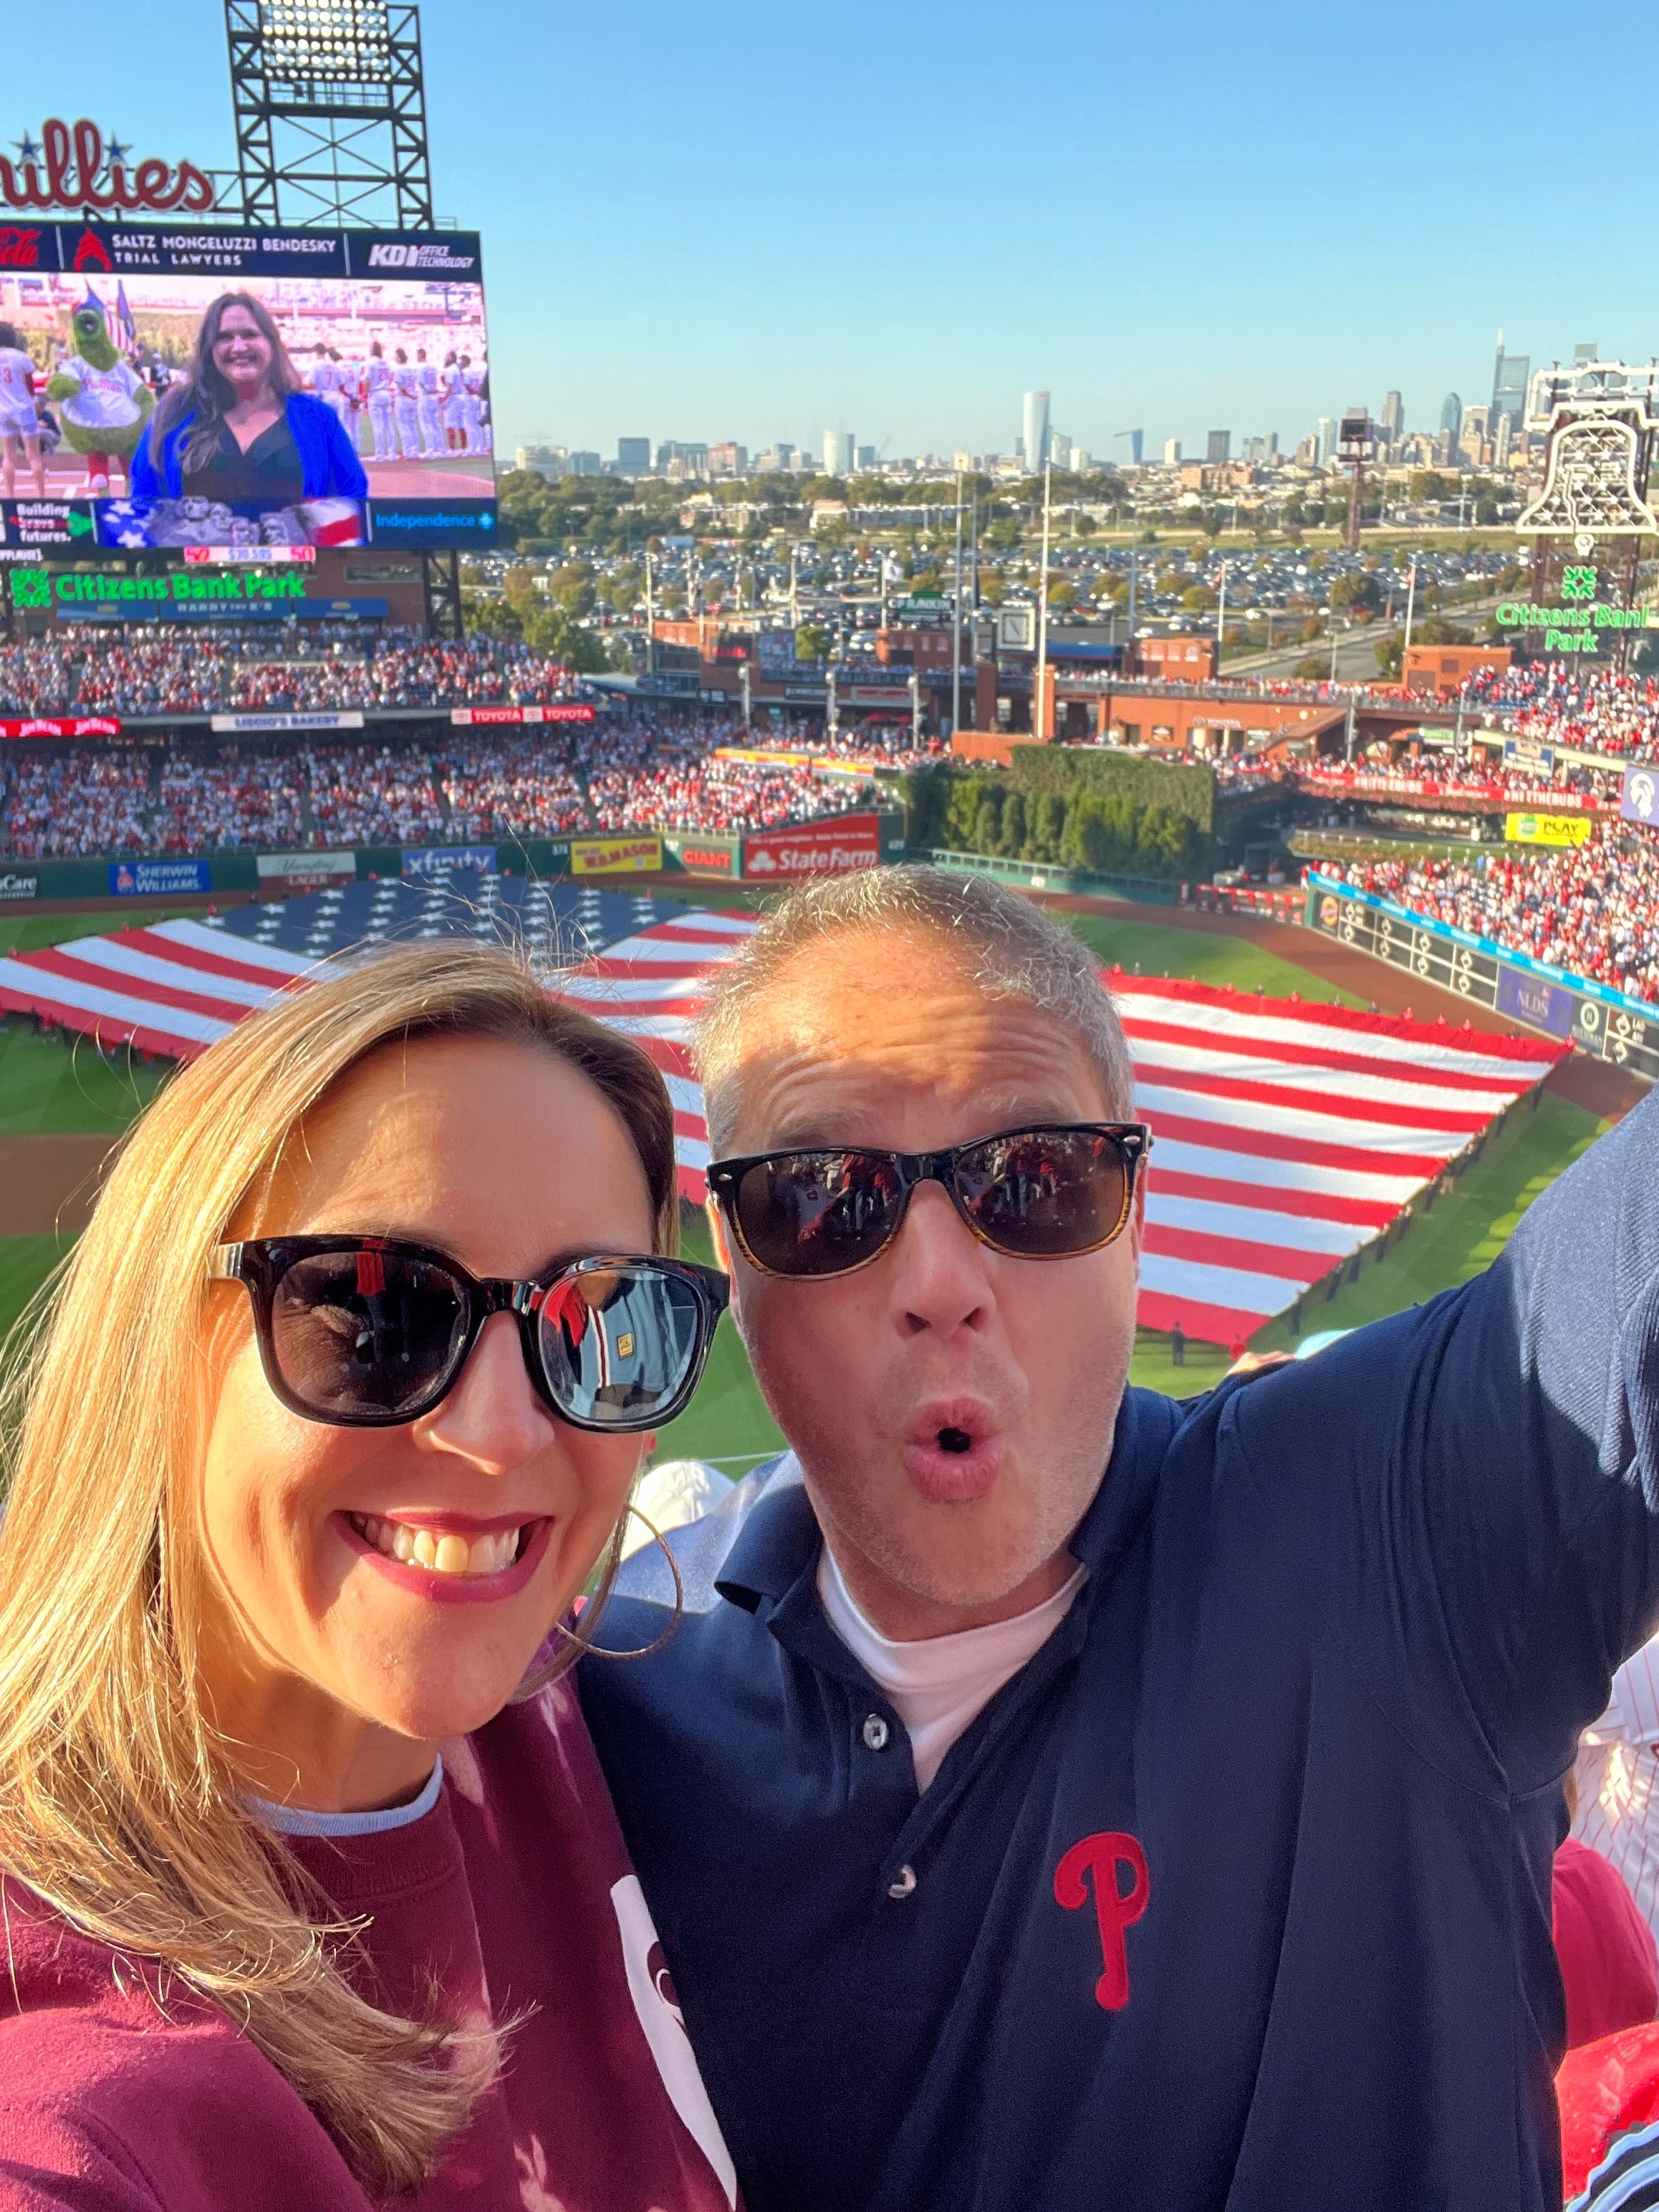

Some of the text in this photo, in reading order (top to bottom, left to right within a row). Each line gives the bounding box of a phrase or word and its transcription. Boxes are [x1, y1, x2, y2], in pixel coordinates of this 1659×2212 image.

[112, 234, 337, 252] SALTZ MONGELUZZI BENDESKY
[418, 246, 450, 256] OFFICE
[114, 252, 242, 266] TRIAL LAWYERS
[417, 256, 475, 268] TECHNOLOGY
[16, 503, 70, 519] Building
[375, 513, 476, 529] Independence
[20, 529, 72, 542] futures.
[56, 571, 306, 601] Citizens Bank Park
[178, 602, 227, 612] HARRY
[1496, 602, 1590, 627] Citizens
[1544, 628, 1599, 653] Park
[473, 710, 522, 721] TOYOTA
[546, 708, 593, 720] TOYOTA
[683, 850, 731, 868] GIANT
[136, 864, 198, 876] SHERWIN
[1517, 988, 1549, 1018] NLDS
[1054, 1831, 1149, 2010] P
